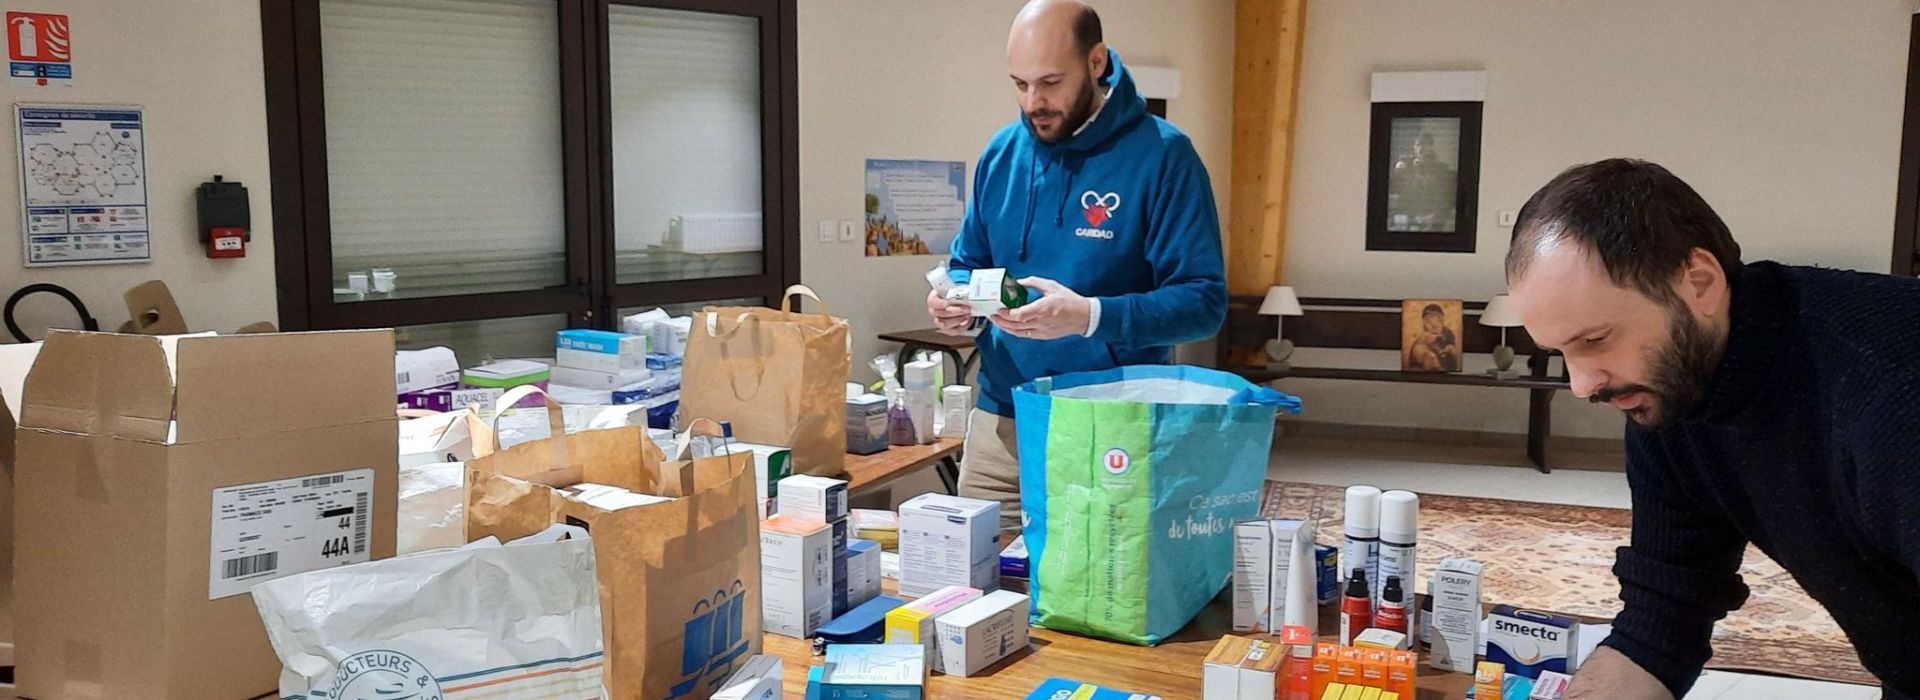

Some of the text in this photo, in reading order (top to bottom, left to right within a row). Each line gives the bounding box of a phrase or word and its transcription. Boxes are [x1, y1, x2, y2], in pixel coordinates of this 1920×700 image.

[1109, 454, 1124, 469] U
[338, 516, 351, 530] 44
[1168, 518, 1185, 539] de
[1186, 512, 1225, 540] toutes
[321, 536, 350, 558] 44A
[1441, 576, 1472, 586] POLERY
[1495, 619, 1558, 642] smecta
[416, 675, 429, 689] &
